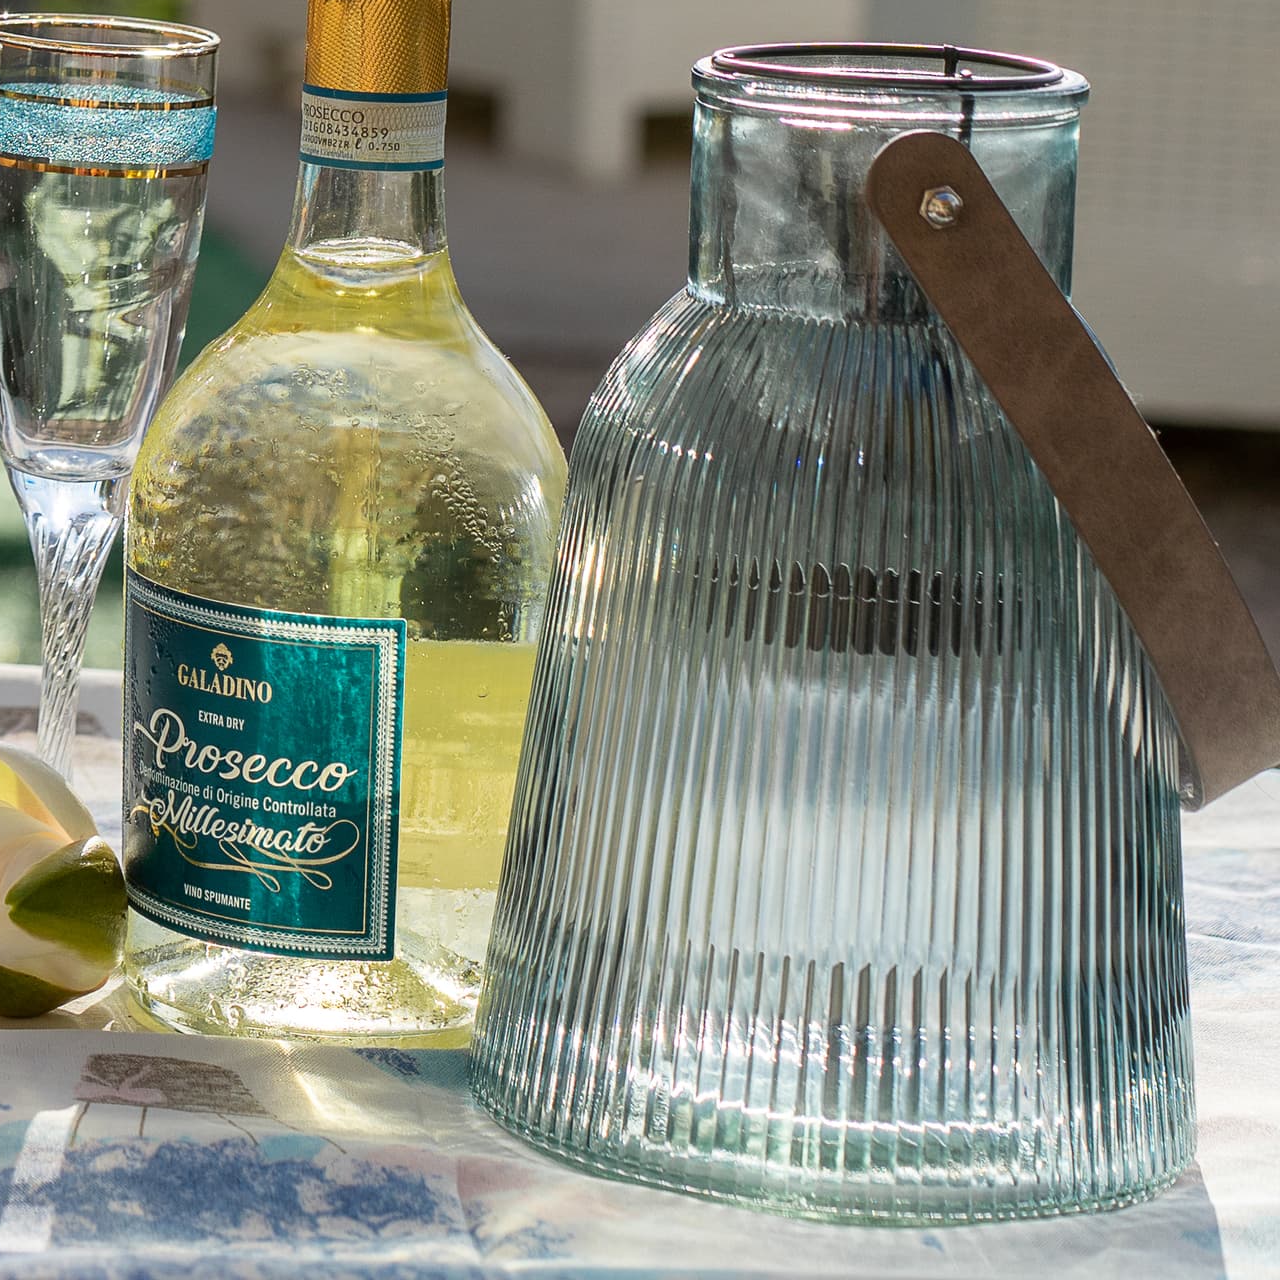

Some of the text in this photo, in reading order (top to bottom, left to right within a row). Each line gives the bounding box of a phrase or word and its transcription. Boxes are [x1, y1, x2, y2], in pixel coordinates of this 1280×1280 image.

[368, 141, 400, 152] 0.750
[177, 663, 273, 704] GALADINO
[198, 709, 245, 732] EXTRA DRY
[133, 707, 358, 792] Prosecco
[139, 759, 337, 818] Denominazione di Origine Controllata
[141, 788, 333, 854] Millesimato
[183, 882, 251, 911] VINO SPUMANTE
